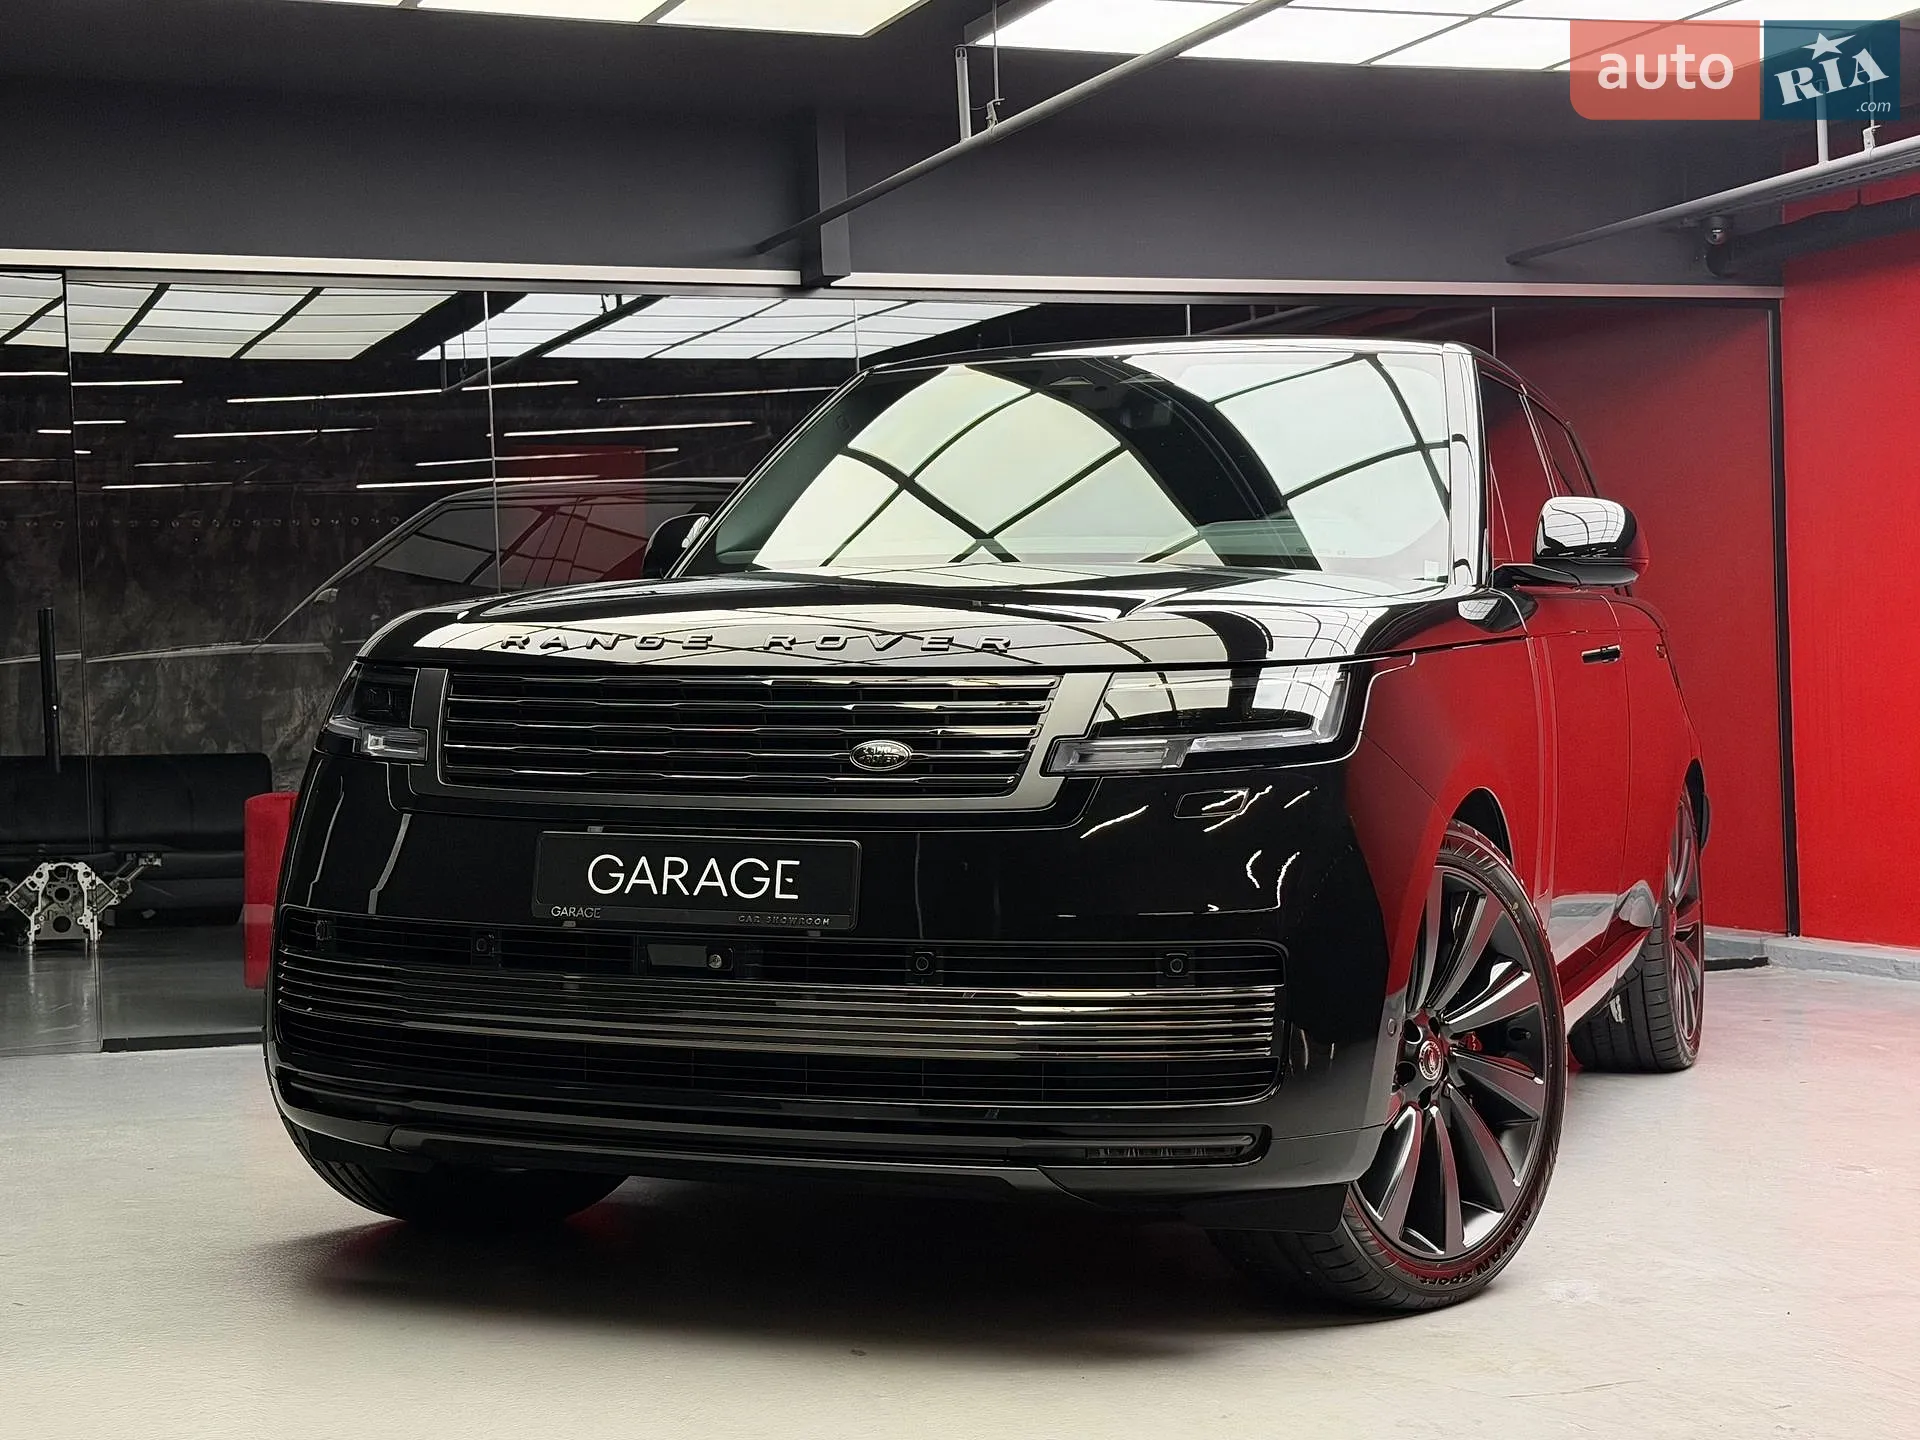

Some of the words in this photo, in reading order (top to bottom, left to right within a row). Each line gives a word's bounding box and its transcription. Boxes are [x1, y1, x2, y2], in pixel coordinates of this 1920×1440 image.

[500, 633, 713, 651] RANGE
[763, 633, 1012, 653] ROVER
[587, 853, 801, 900] GARAGE
[550, 905, 601, 919] GARAGE
[738, 914, 761, 924] CAR
[766, 915, 830, 926] SHOWROOM
